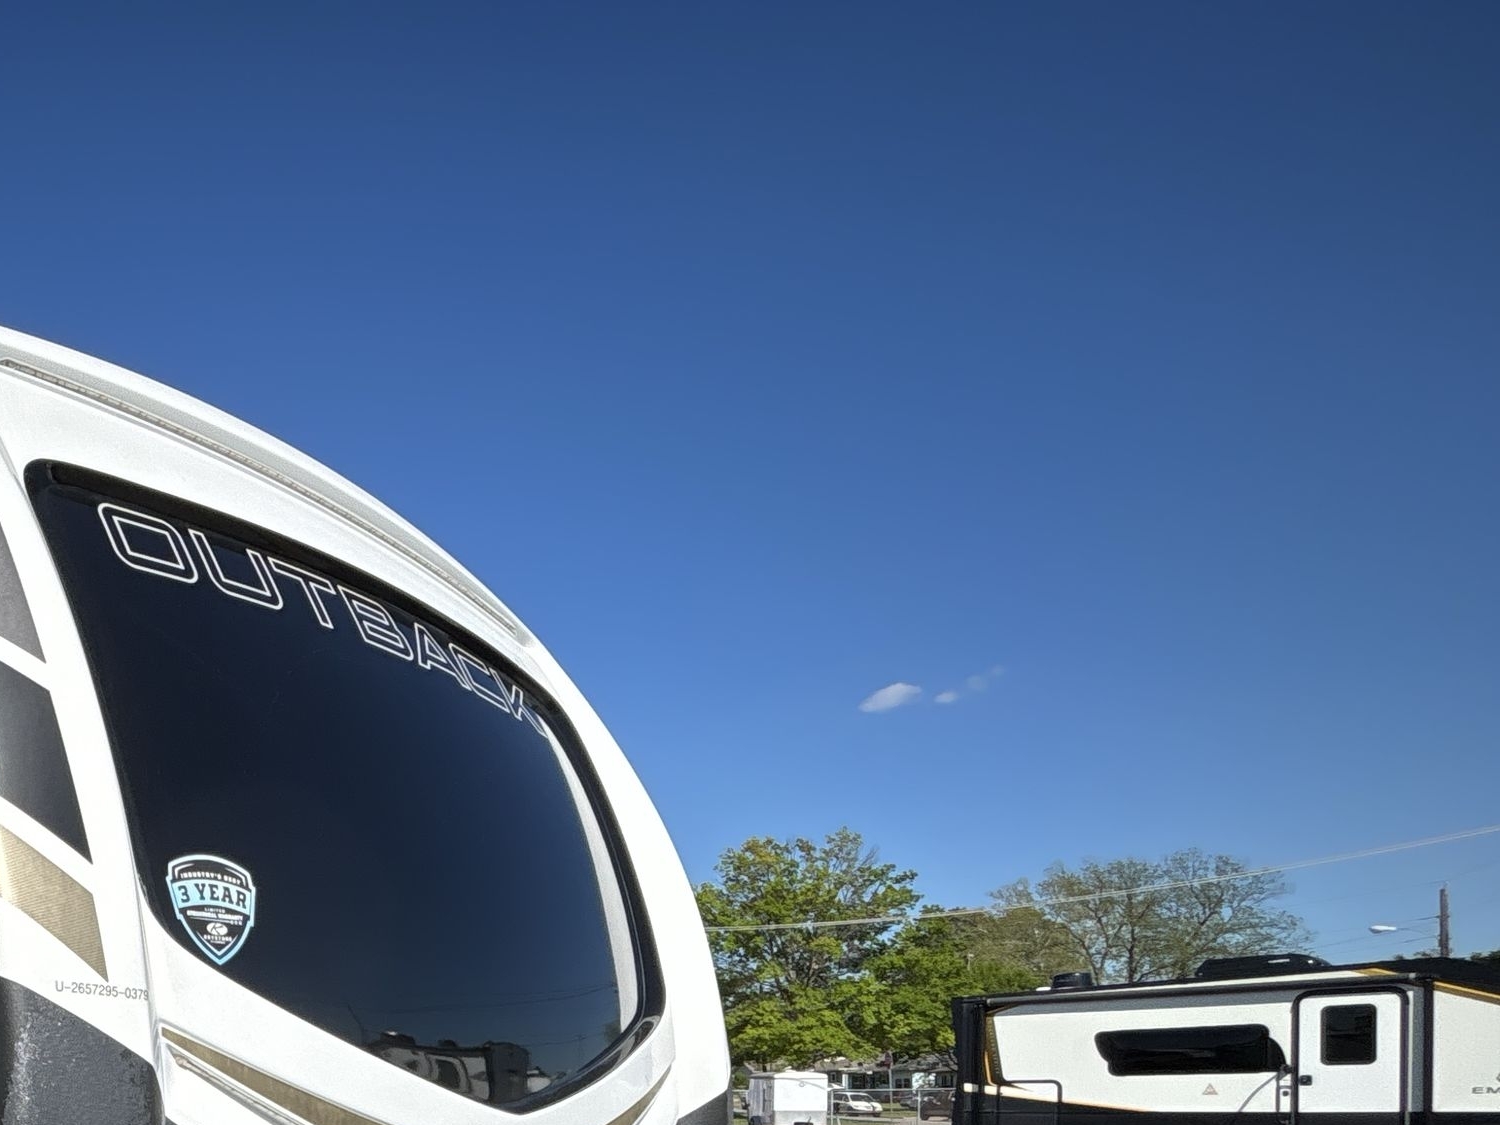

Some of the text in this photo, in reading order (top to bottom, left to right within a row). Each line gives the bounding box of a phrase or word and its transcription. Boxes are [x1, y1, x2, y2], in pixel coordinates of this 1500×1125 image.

[97, 502, 550, 738] OUTBACK
[177, 883, 247, 909] 3 YEAR
[55, 980, 150, 1001] U-2657295-0379
